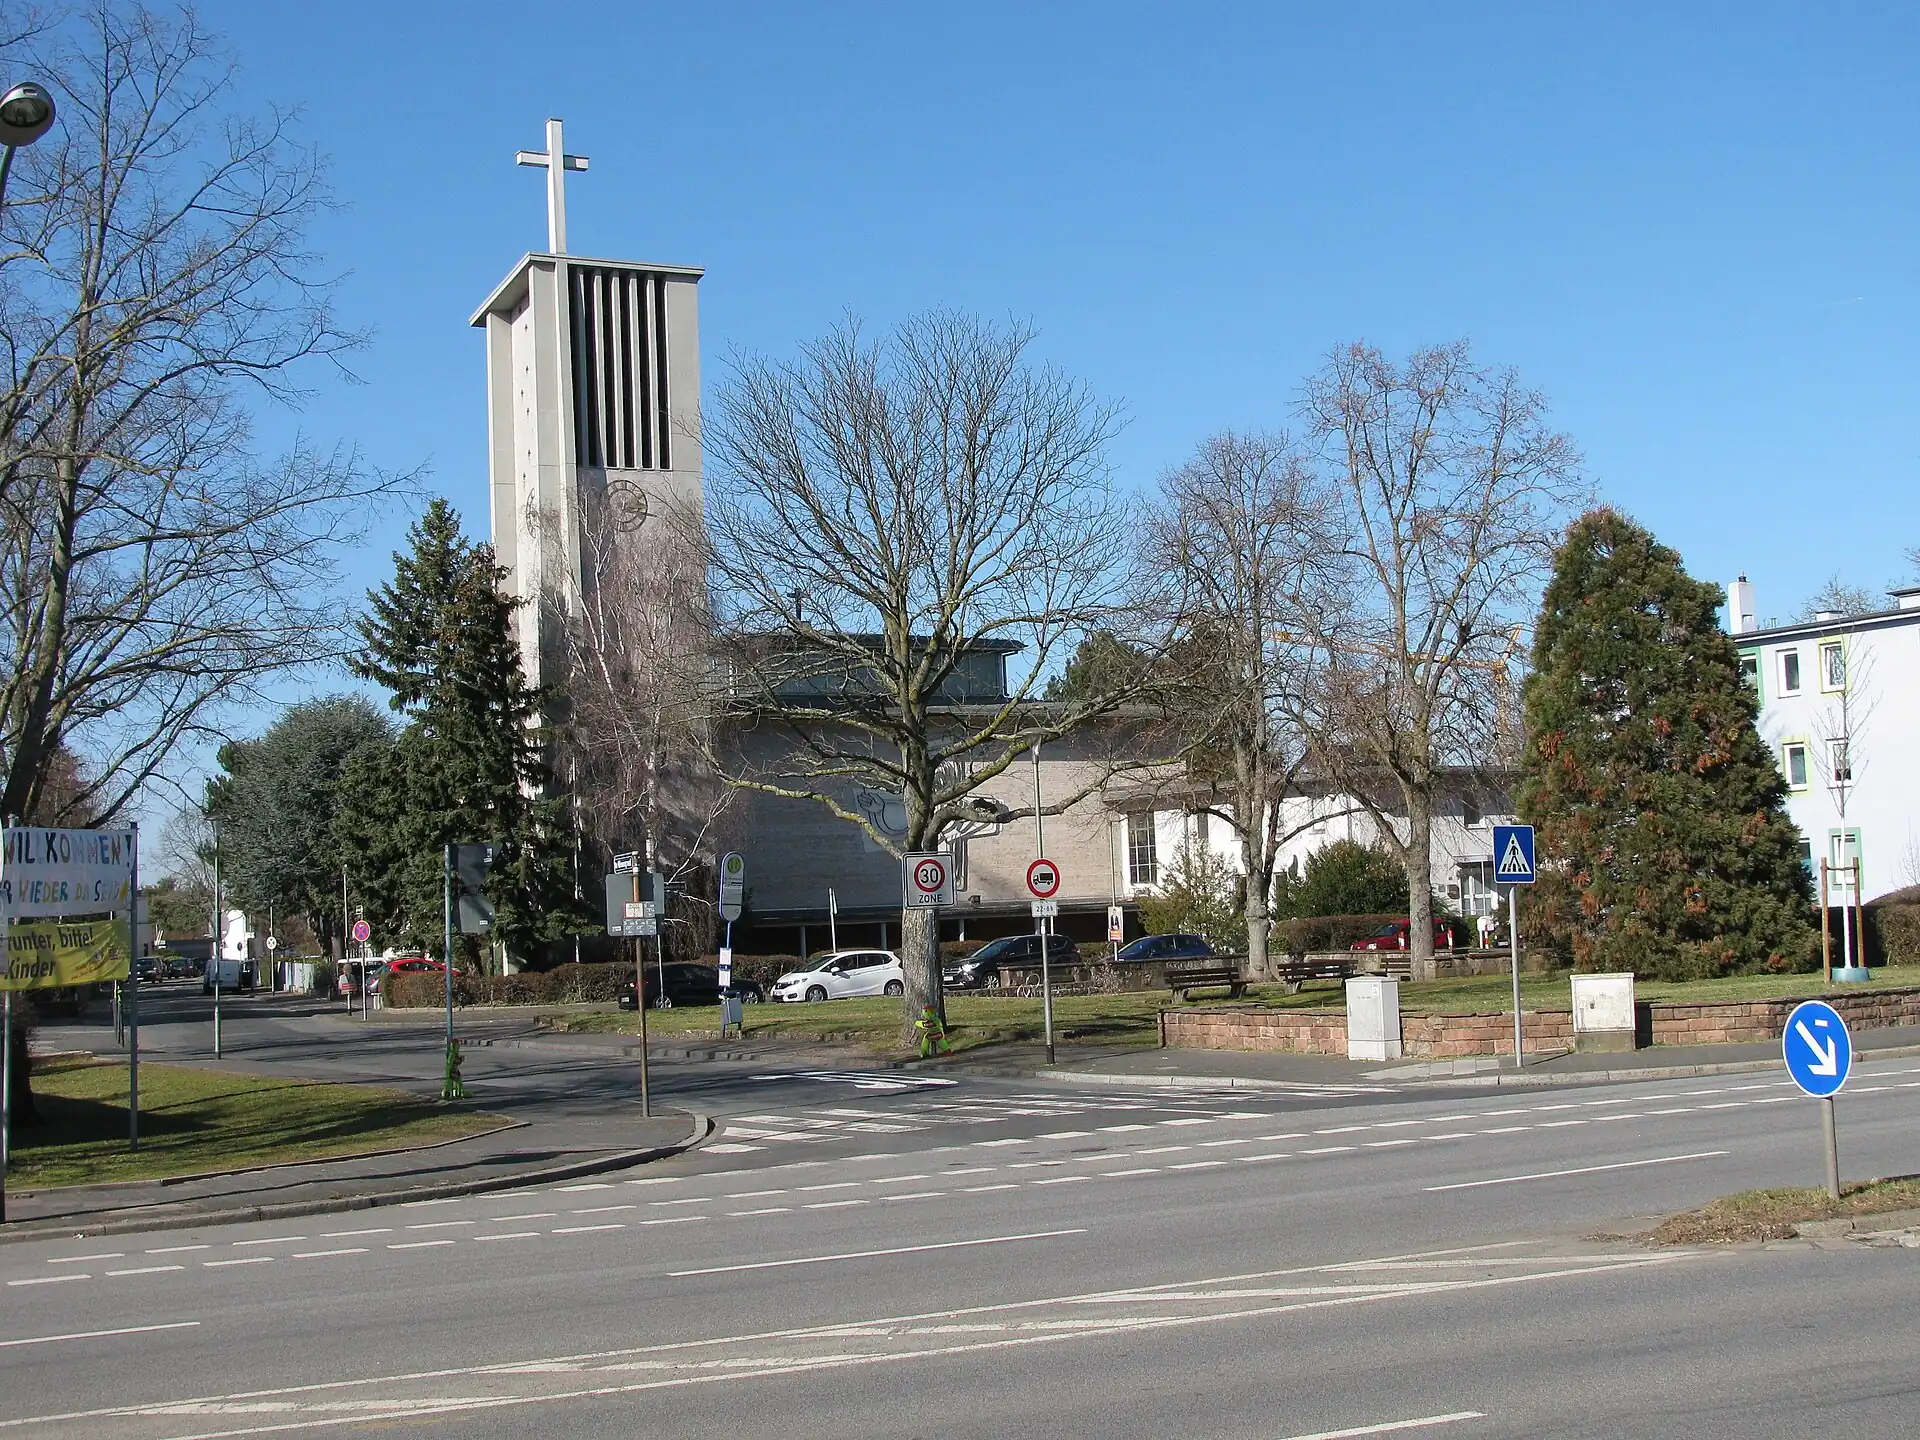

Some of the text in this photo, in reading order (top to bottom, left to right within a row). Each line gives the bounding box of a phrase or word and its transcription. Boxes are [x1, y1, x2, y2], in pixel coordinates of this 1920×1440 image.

[920, 868, 939, 884] 30
[20, 879, 68, 903] WIEDER
[919, 893, 943, 903] ZONE
[57, 926, 94, 948] bitte!
